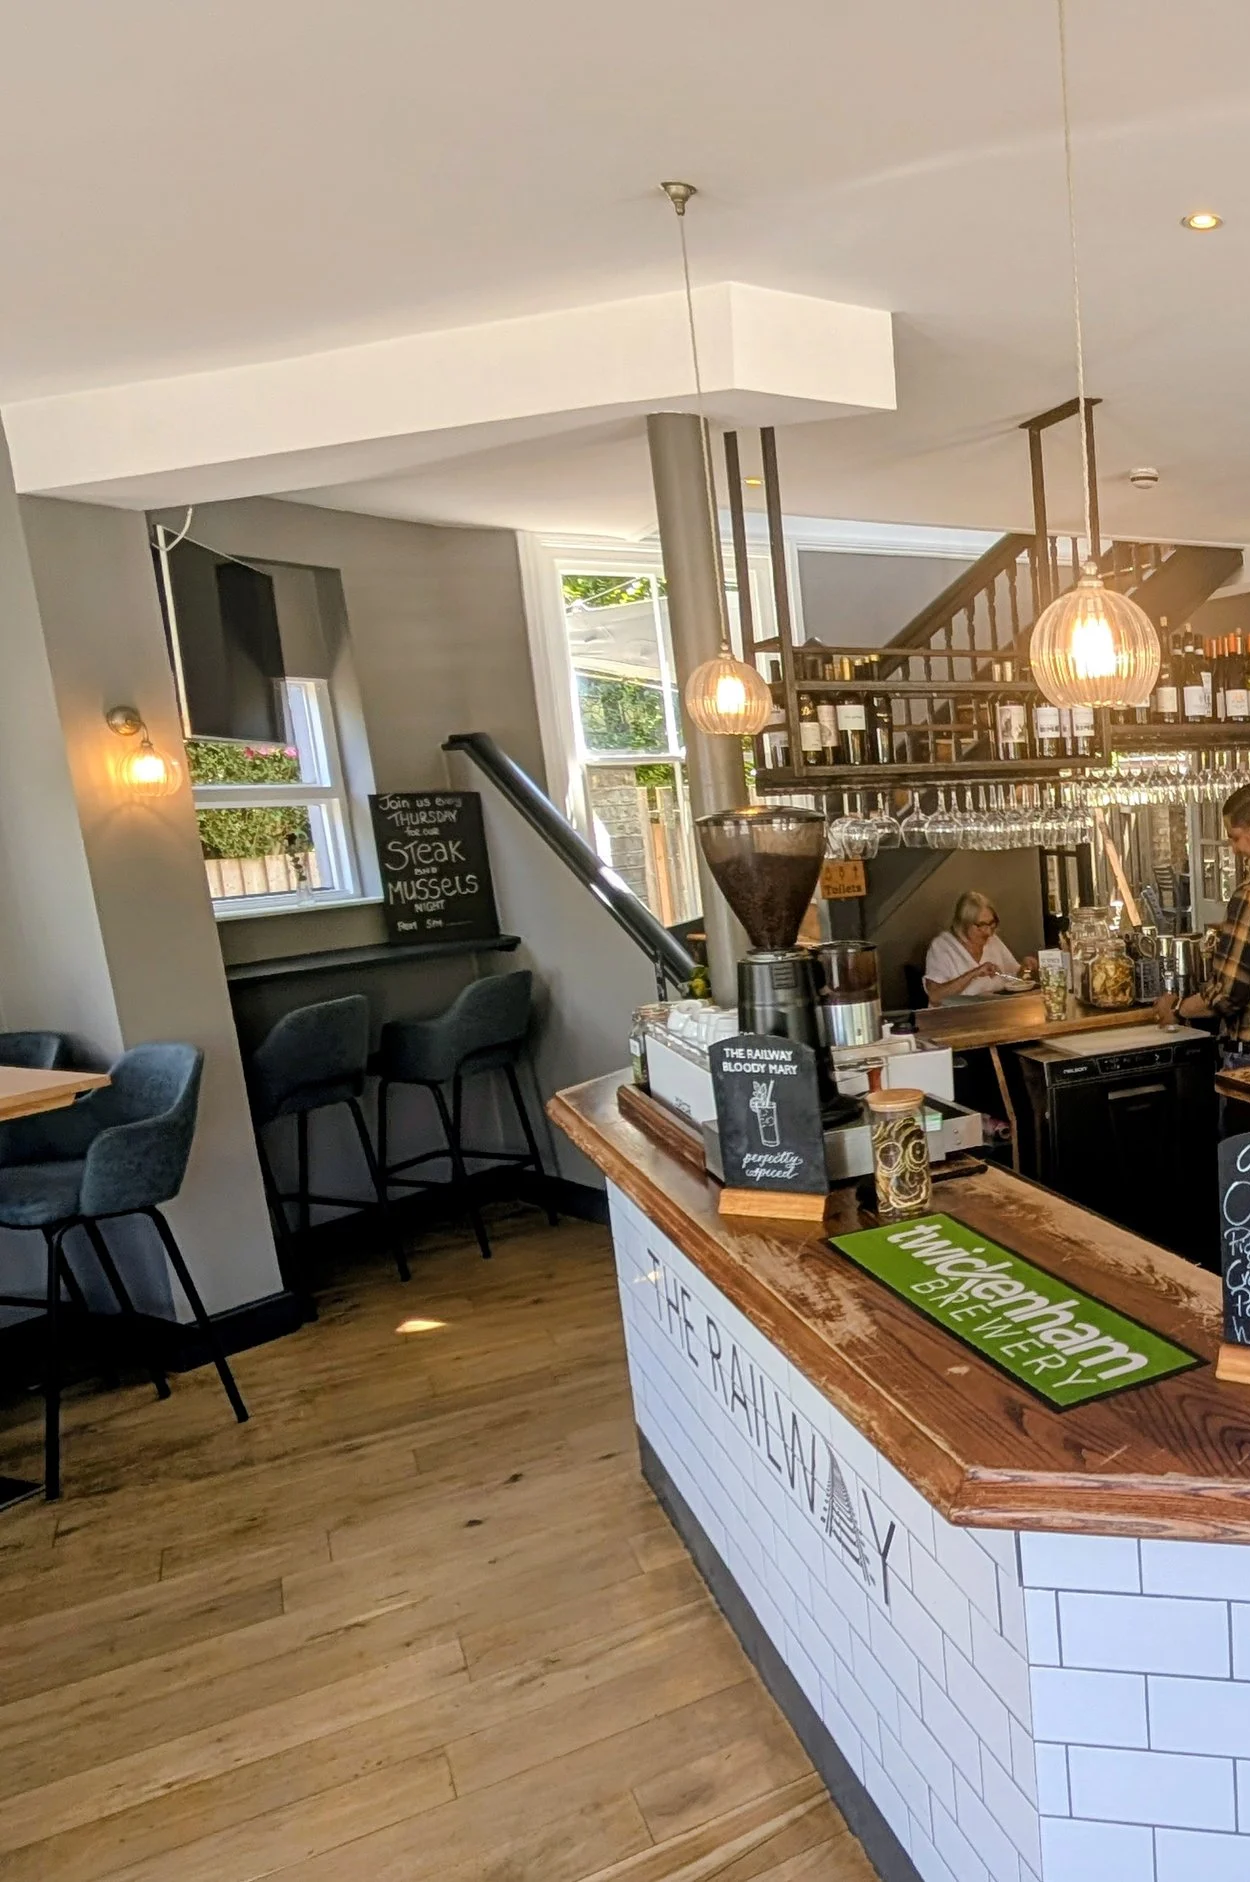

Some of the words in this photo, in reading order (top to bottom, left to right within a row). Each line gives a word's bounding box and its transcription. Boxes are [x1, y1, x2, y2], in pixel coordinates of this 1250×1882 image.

[379, 794, 410, 811] Join
[415, 799, 431, 807] us
[387, 809, 458, 827] THURSDAY
[414, 899, 446, 913] NIGHT
[723, 1048, 746, 1059] THE
[746, 1048, 793, 1062] RAILWAY
[722, 1061, 767, 1073] BLOODY
[768, 1063, 798, 1075] MARY
[742, 1151, 804, 1169] perfectly
[745, 1165, 799, 1181] spiced
[886, 1223, 1149, 1381] twickenham
[910, 1278, 1097, 1391] BREWERY
[647, 1247, 699, 1369] THE
[706, 1314, 897, 1606] RAILWAY
